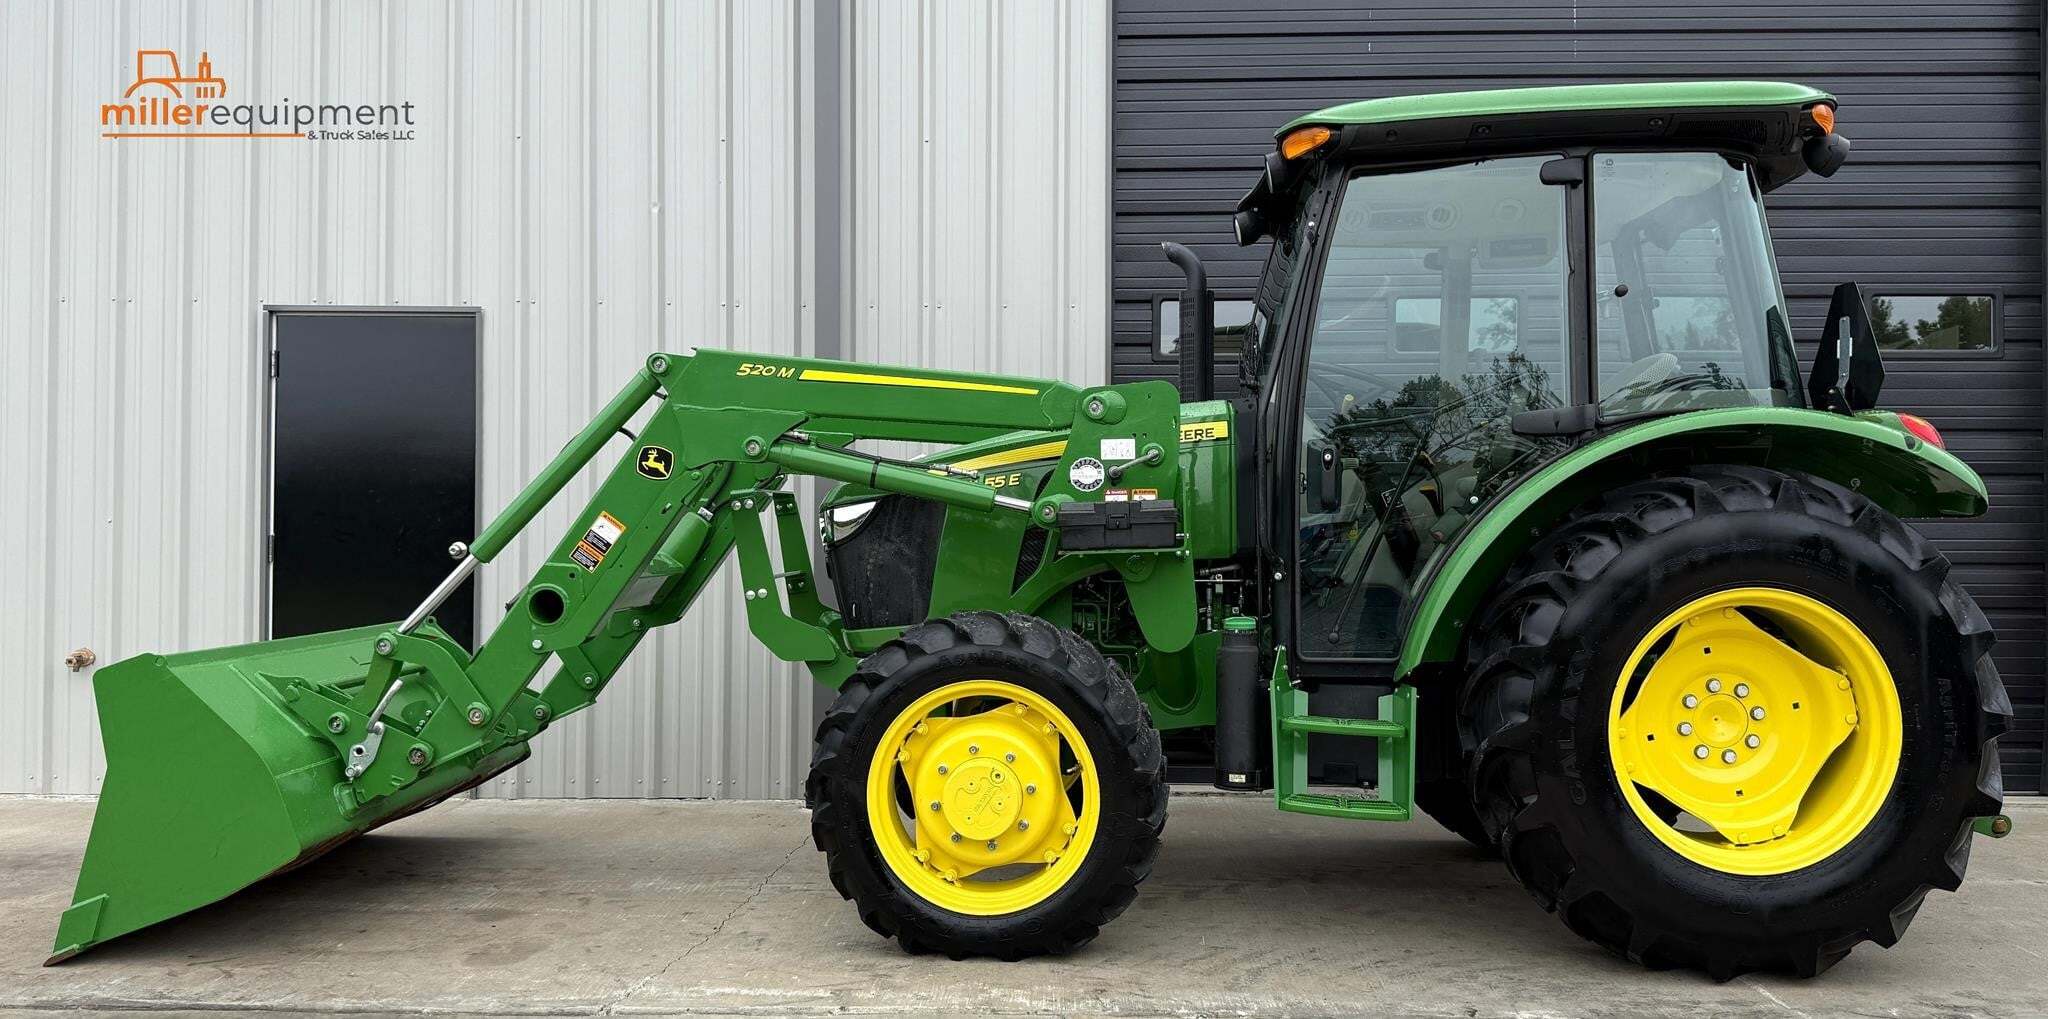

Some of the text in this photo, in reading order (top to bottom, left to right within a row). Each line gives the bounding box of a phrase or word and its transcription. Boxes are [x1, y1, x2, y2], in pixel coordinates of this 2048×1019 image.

[736, 362, 797, 379] 520 M
[1008, 472, 1022, 487] E
